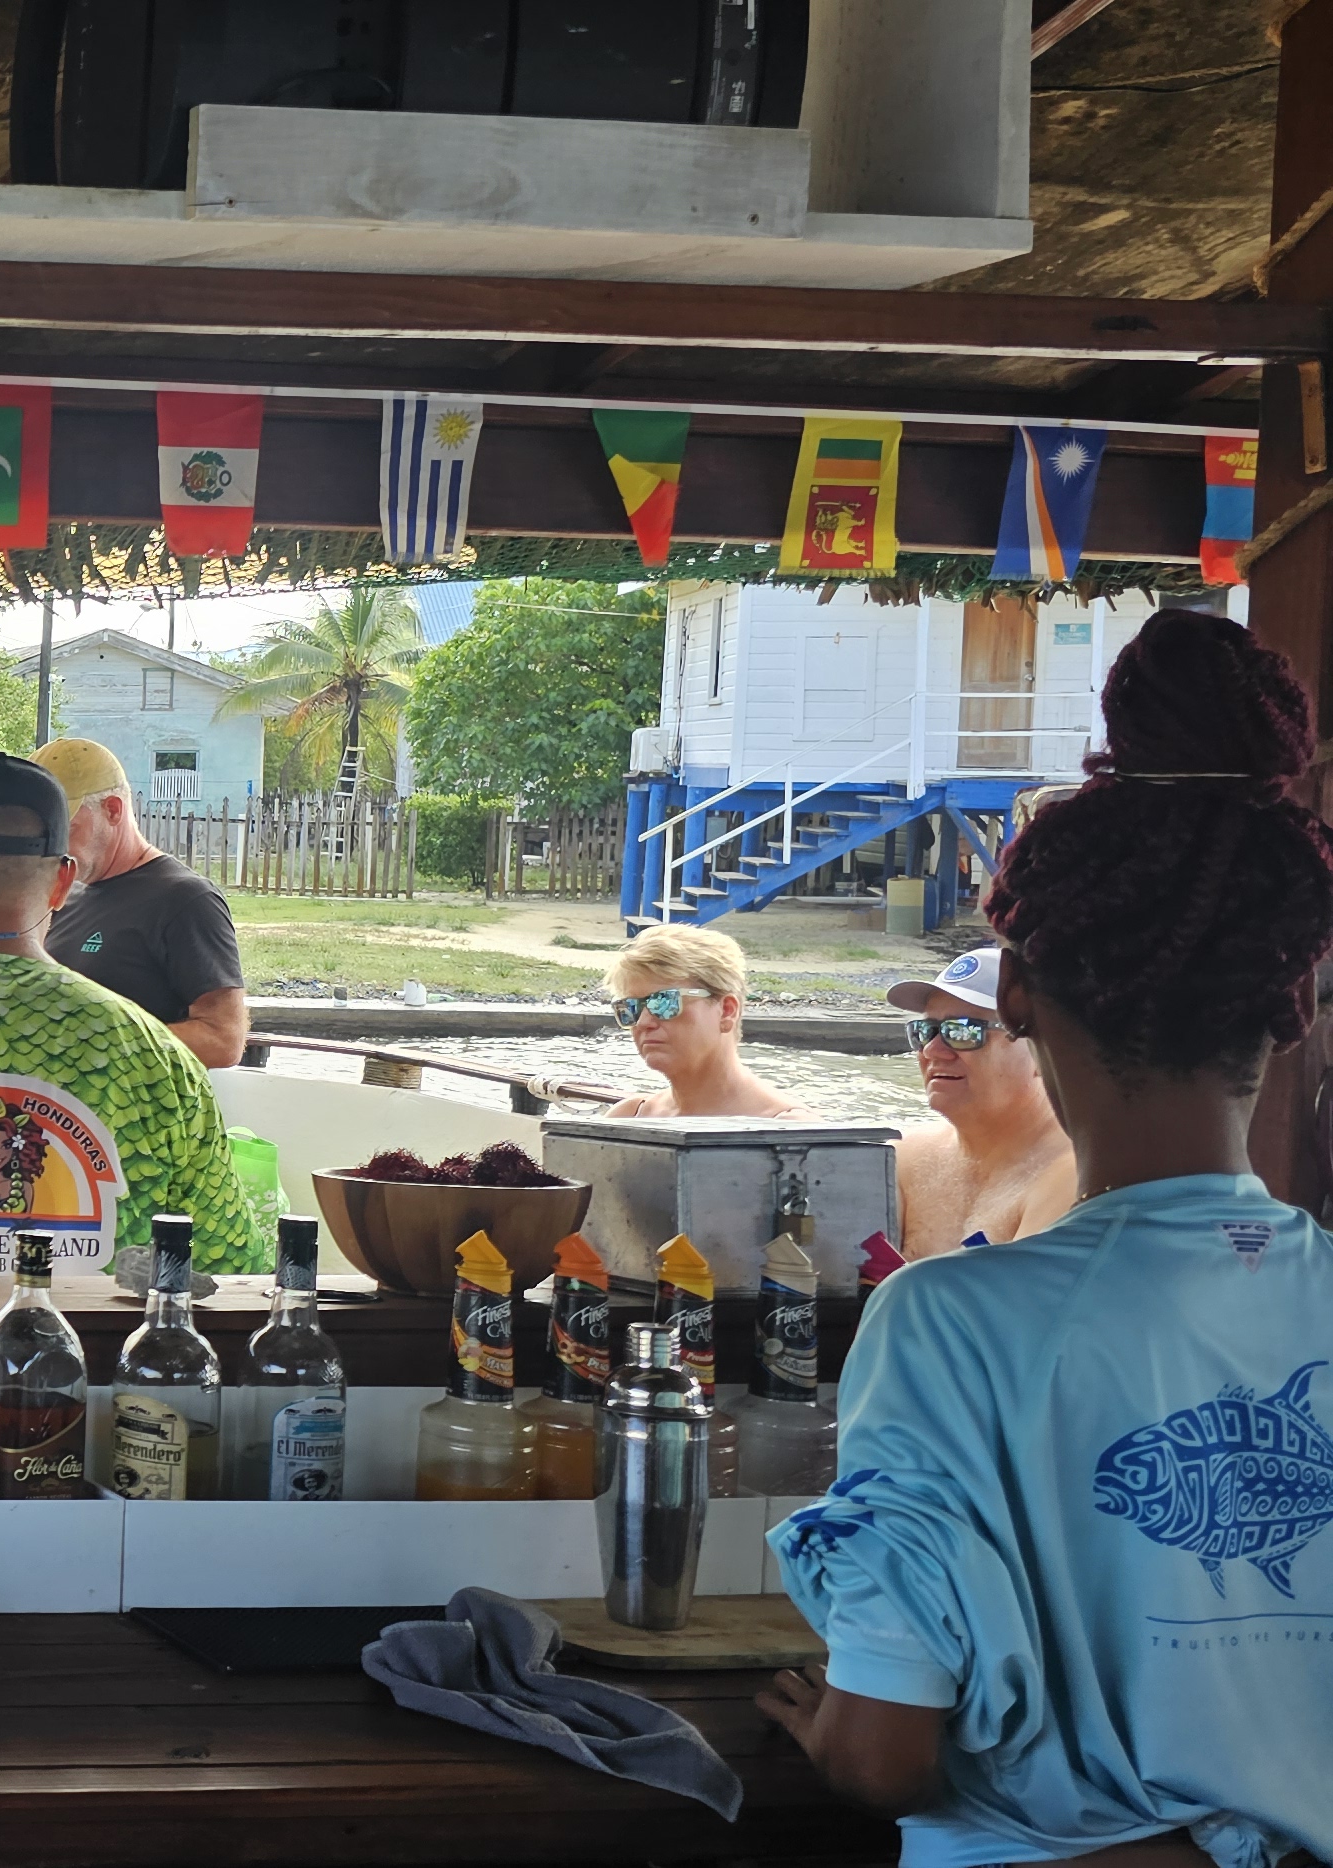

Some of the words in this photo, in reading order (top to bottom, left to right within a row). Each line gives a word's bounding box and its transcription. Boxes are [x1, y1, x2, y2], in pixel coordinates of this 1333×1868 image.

[22, 1096, 107, 1172] HONDURAS
[1221, 1224, 1272, 1232] PFG
[277, 1439, 290, 1456] El
[14, 1456, 48, 1481] Flor
[58, 1454, 83, 1479] Caña
[1151, 1636, 1210, 1650] TRUE
[1219, 1636, 1238, 1647] TO
